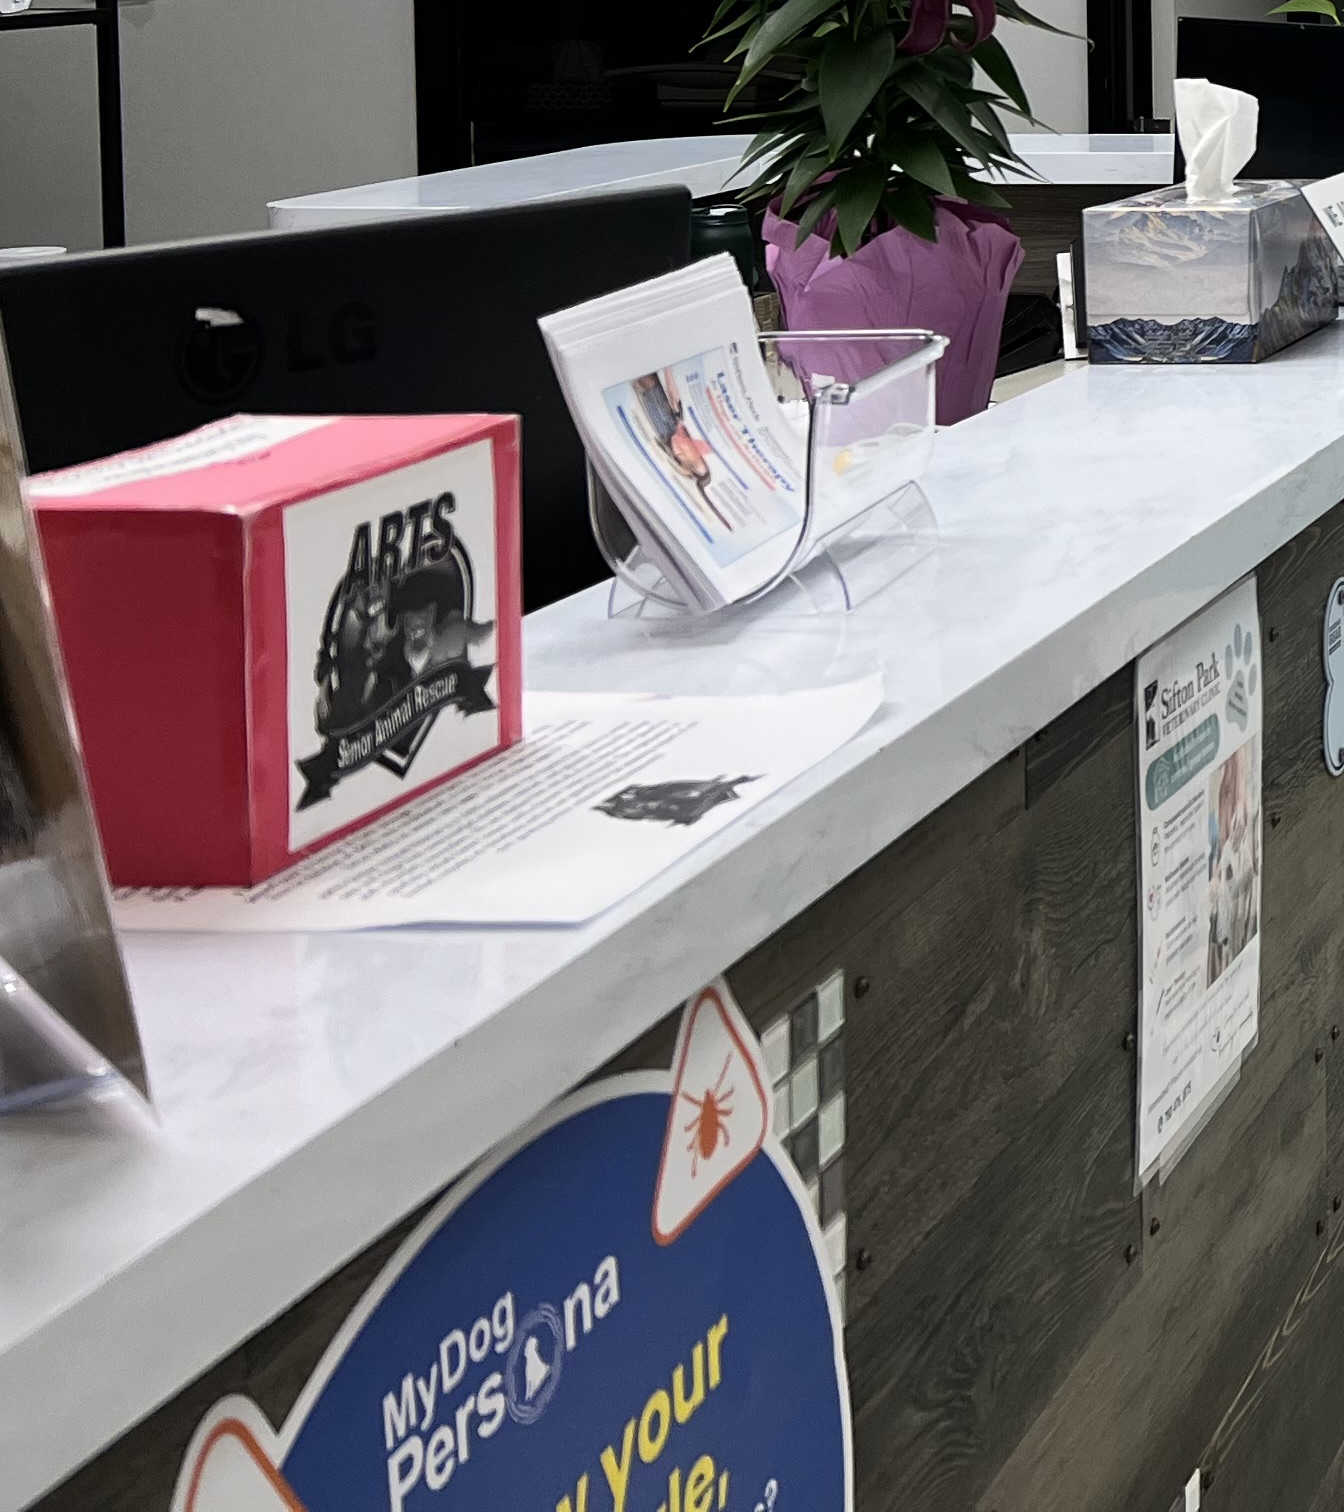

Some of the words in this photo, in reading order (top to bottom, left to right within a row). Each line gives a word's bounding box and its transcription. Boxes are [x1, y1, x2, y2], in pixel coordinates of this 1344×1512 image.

[350, 490, 457, 584] ARTS
[374, 691, 416, 747] Animal
[413, 672, 459, 713] Rescue
[1160, 678, 1195, 721] Sifton
[1194, 650, 1222, 694] Park
[381, 1290, 518, 1450] MyDog
[599, 1311, 731, 1512] your
